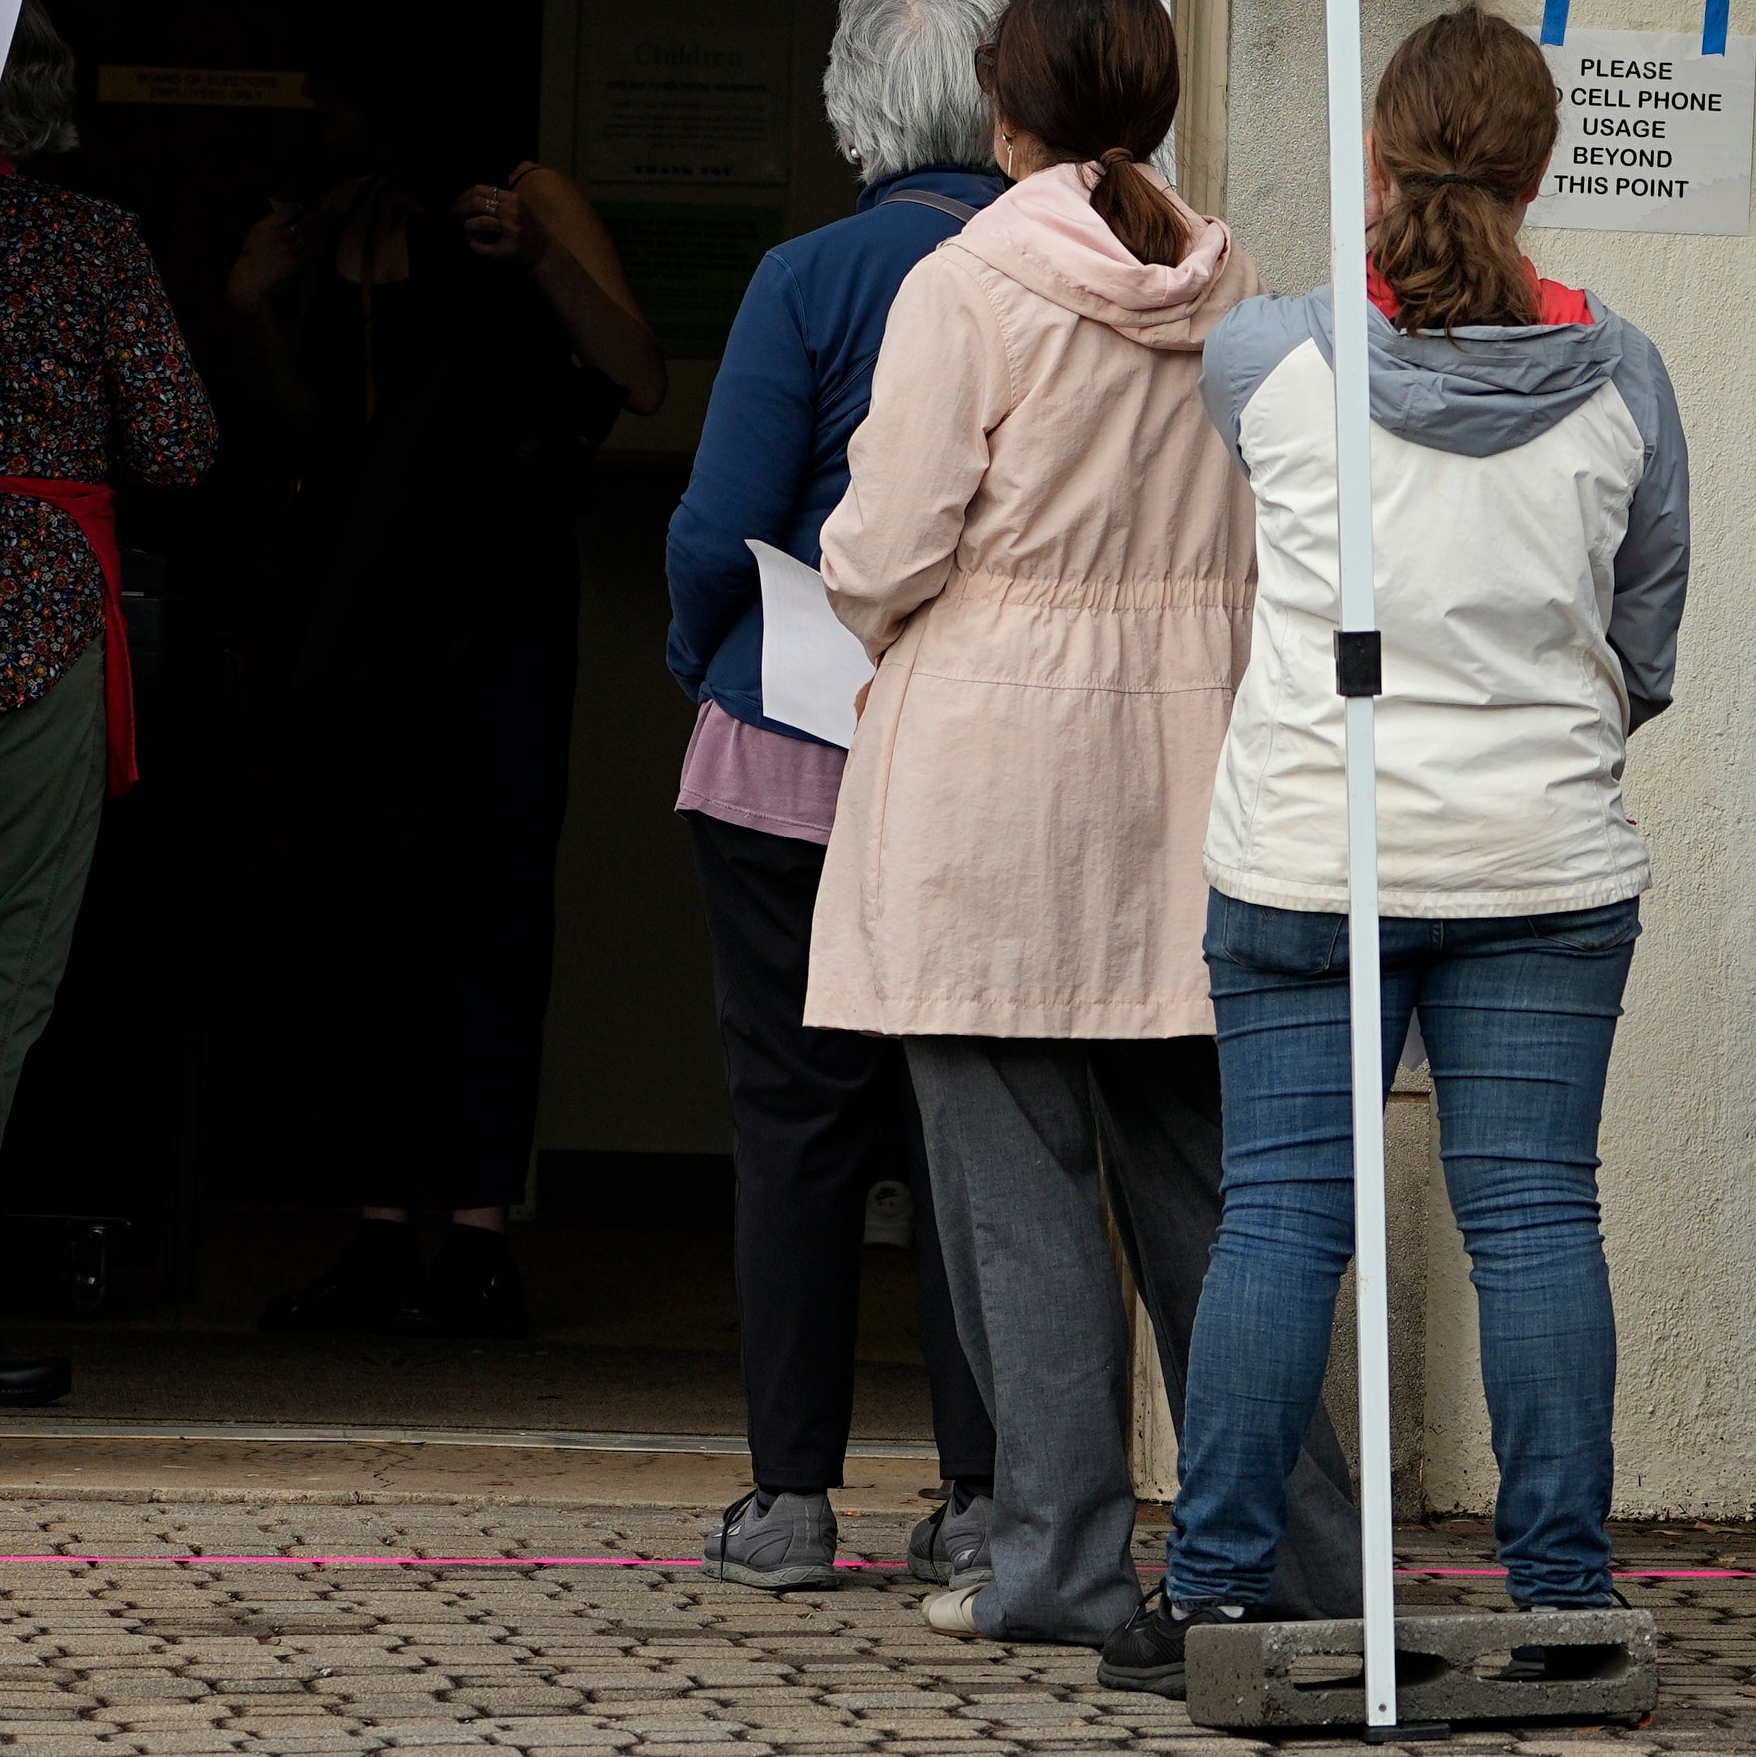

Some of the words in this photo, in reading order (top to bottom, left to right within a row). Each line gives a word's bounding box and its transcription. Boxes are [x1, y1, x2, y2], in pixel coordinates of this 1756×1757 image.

[1580, 59, 1673, 80] PLEASE
[1571, 87, 1631, 108] CELL
[1638, 90, 1722, 112] PHONE
[1582, 117, 1666, 139] USAGE
[1573, 146, 1673, 168] BEYOND
[1554, 175, 1608, 194] THIS
[1616, 178, 1689, 198] POINT
